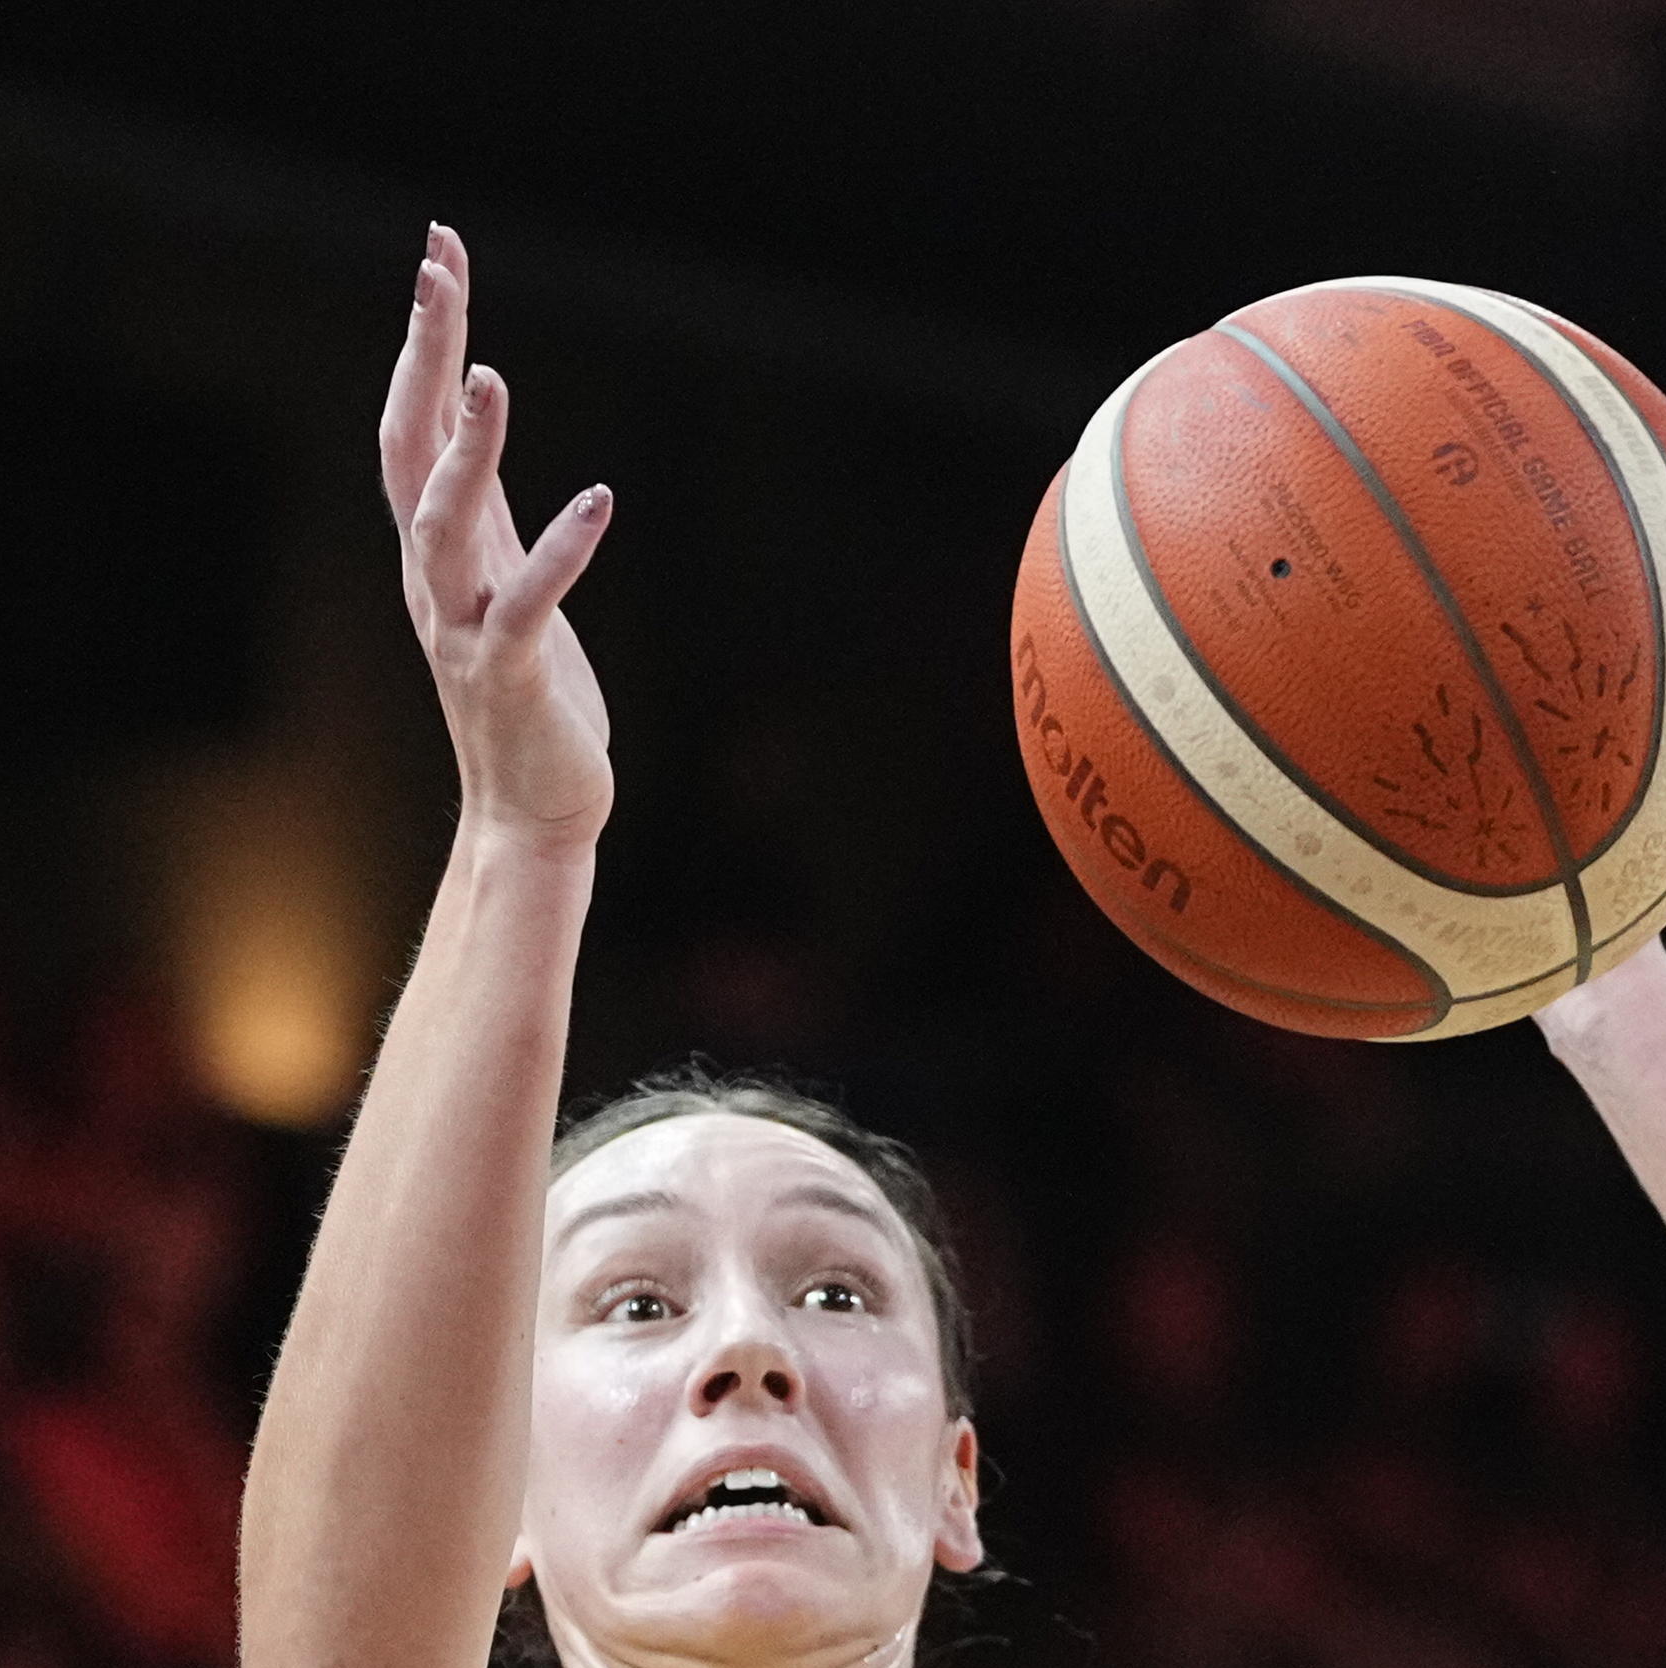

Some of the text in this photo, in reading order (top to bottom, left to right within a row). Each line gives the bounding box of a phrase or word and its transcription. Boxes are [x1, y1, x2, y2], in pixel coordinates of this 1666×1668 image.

[1446, 358, 1531, 455] OFFICIAL
[1521, 456, 1574, 533] GAME
[1563, 538, 1612, 605] BALL
[1016, 631, 1193, 914] molten
